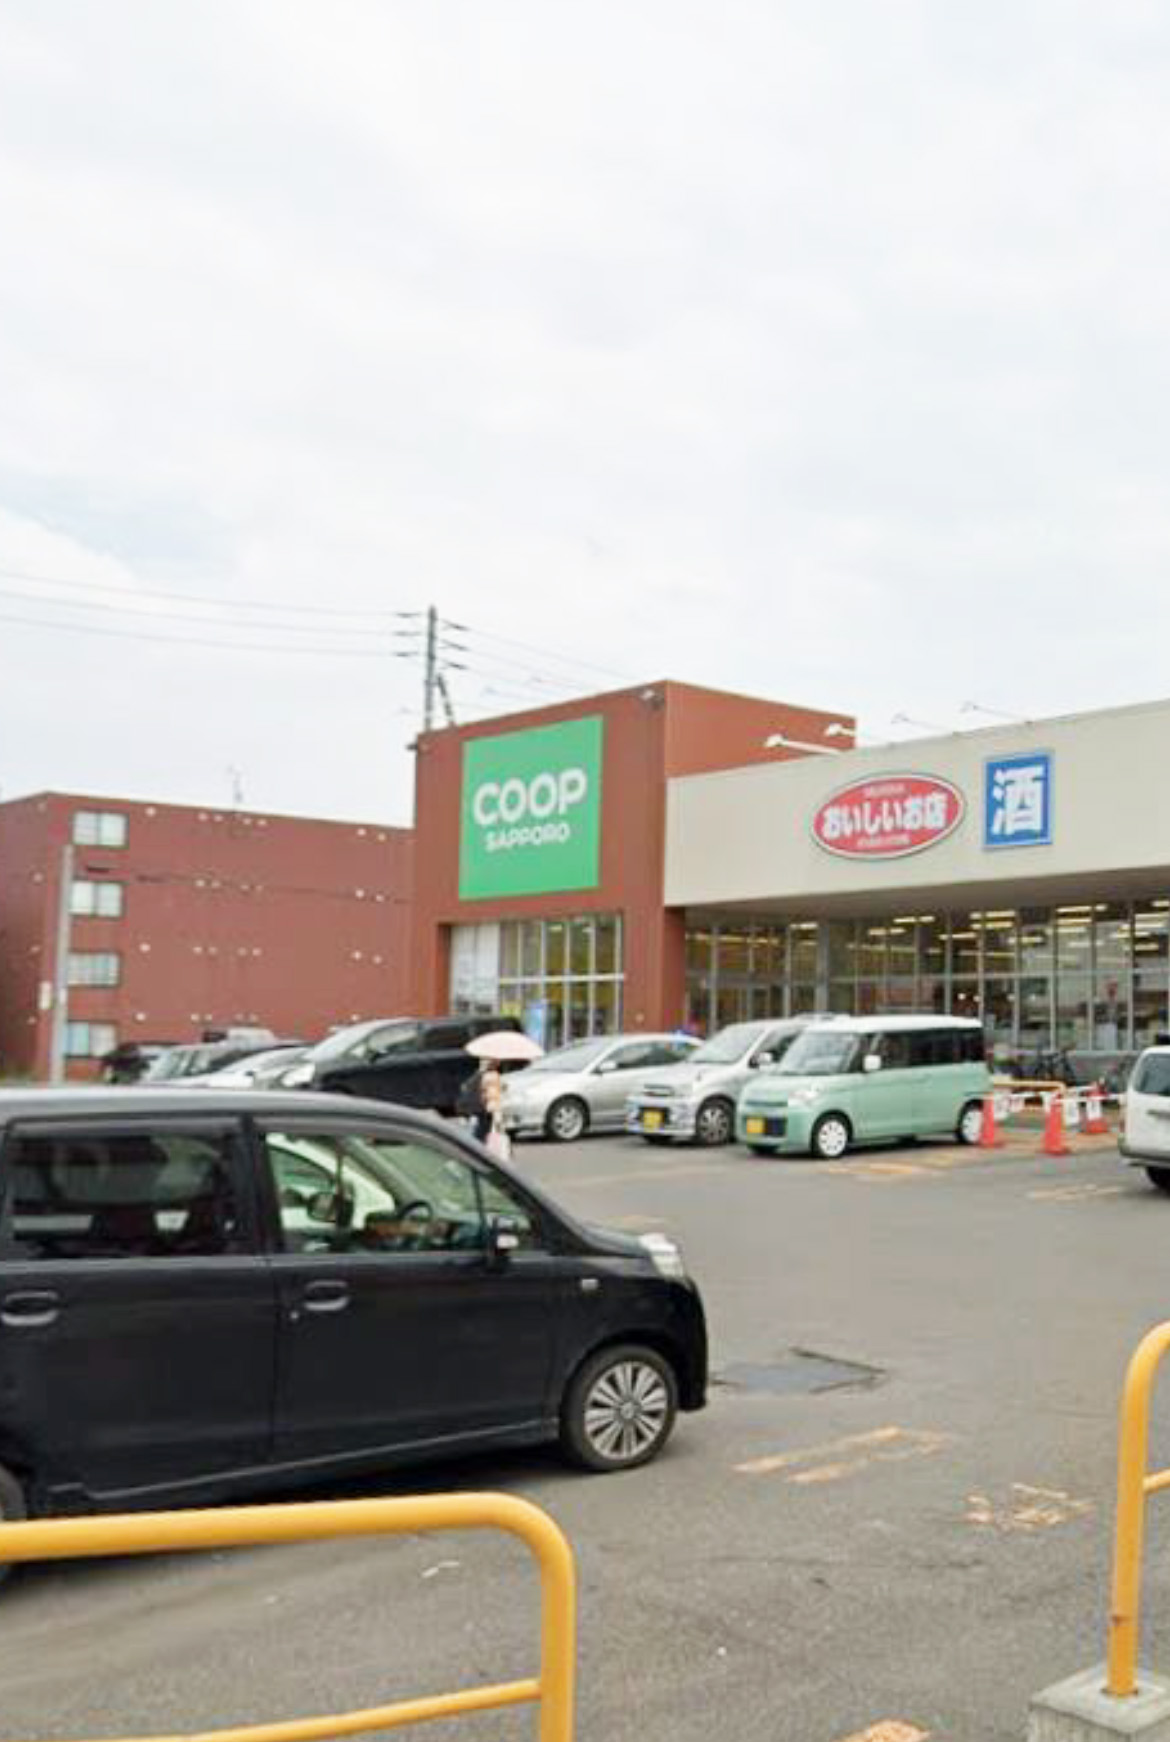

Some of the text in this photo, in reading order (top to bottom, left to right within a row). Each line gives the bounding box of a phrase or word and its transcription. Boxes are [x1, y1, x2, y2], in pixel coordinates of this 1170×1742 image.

[473, 767, 589, 826] COOP
[822, 792, 947, 840] おいしいお店
[993, 765, 1043, 836] 酒
[485, 821, 570, 853] SAPPORO
